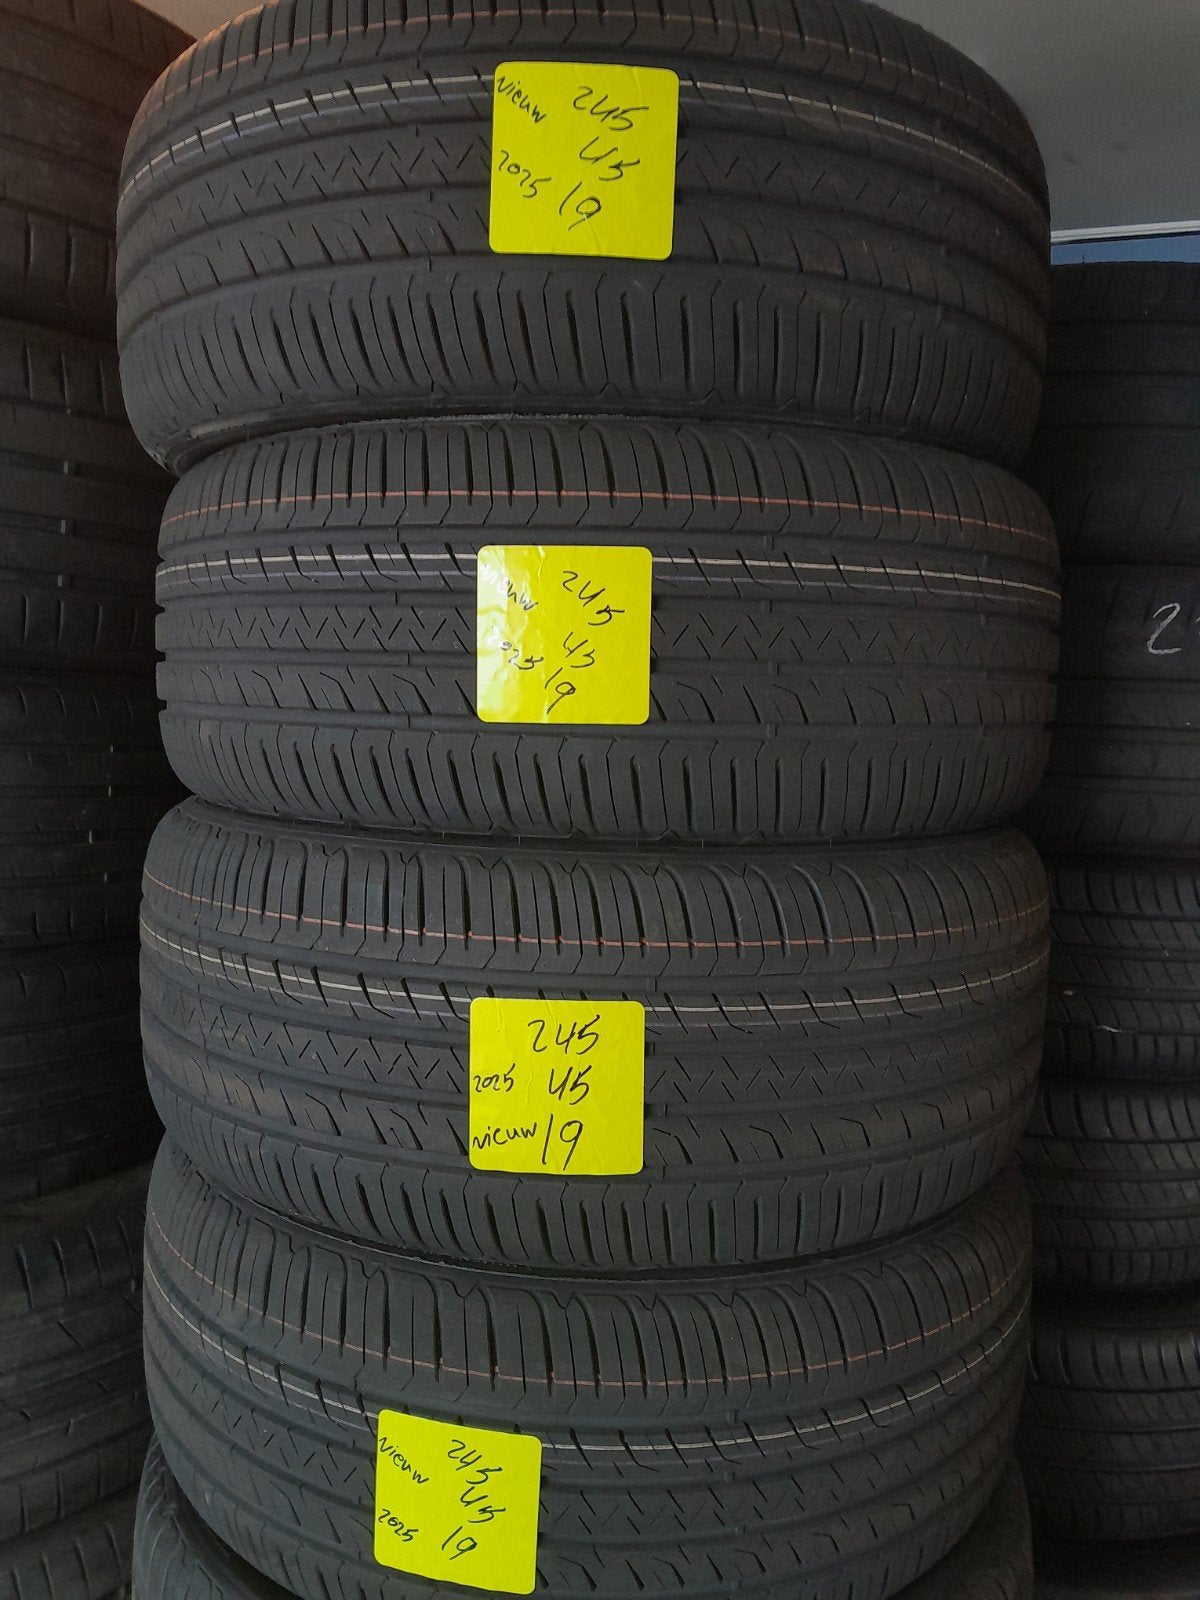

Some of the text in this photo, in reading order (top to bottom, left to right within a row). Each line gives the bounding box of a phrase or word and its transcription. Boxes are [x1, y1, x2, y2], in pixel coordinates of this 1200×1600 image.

[573, 85, 649, 131] 245
[498, 149, 552, 198] 2025
[579, 136, 640, 181] 45
[559, 181, 602, 231] 19
[562, 570, 625, 626] 245
[1146, 602, 1200, 656] 2
[544, 667, 577, 715] 19
[527, 1014, 601, 1055] 245
[473, 1063, 516, 1093] 2025
[548, 1064, 592, 1106] 45
[541, 1113, 583, 1171] 19
[447, 1439, 503, 1485] 245
[377, 1508, 419, 1543] 2025
[460, 1486, 507, 1523] 45
[441, 1525, 478, 1561] 19
